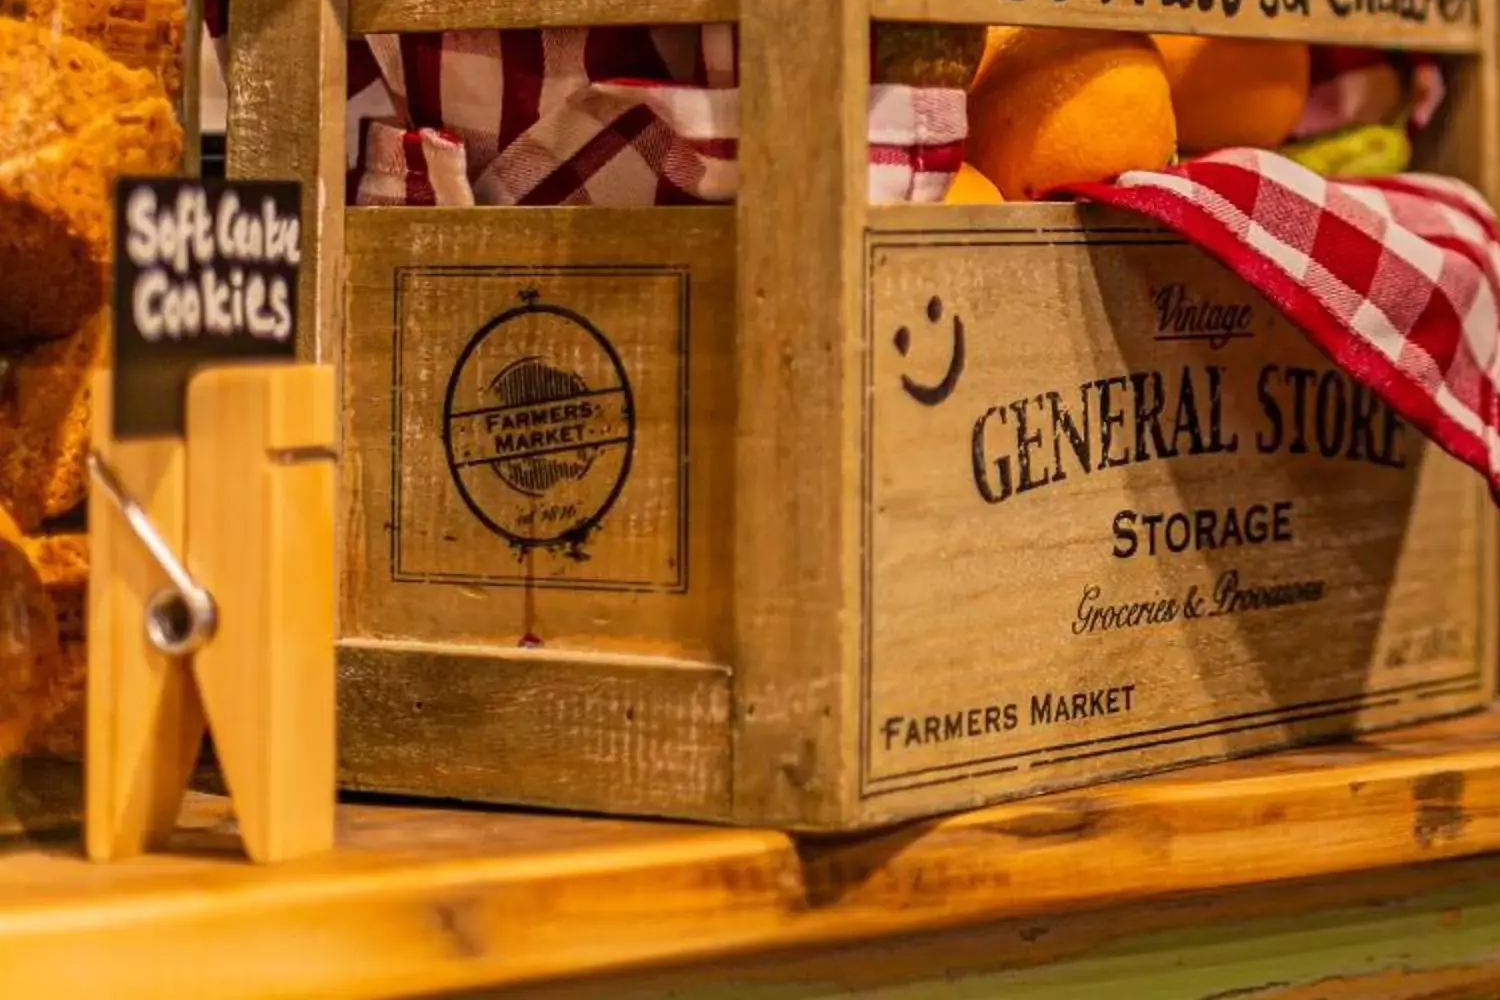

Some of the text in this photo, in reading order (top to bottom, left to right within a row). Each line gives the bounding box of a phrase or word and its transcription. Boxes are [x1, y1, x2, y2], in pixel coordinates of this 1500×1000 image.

[127, 186, 214, 273] Soft
[132, 266, 291, 343] Cookies
[1152, 283, 1253, 349] Vintage
[495, 424, 584, 453] MARKET
[971, 364, 1407, 504] GENERAL STORE
[1112, 502, 1293, 558] STORAGE
[1072, 583, 1178, 635] Groceries
[1183, 584, 1204, 618] &
[881, 684, 1136, 750] FARMERS MARKET
